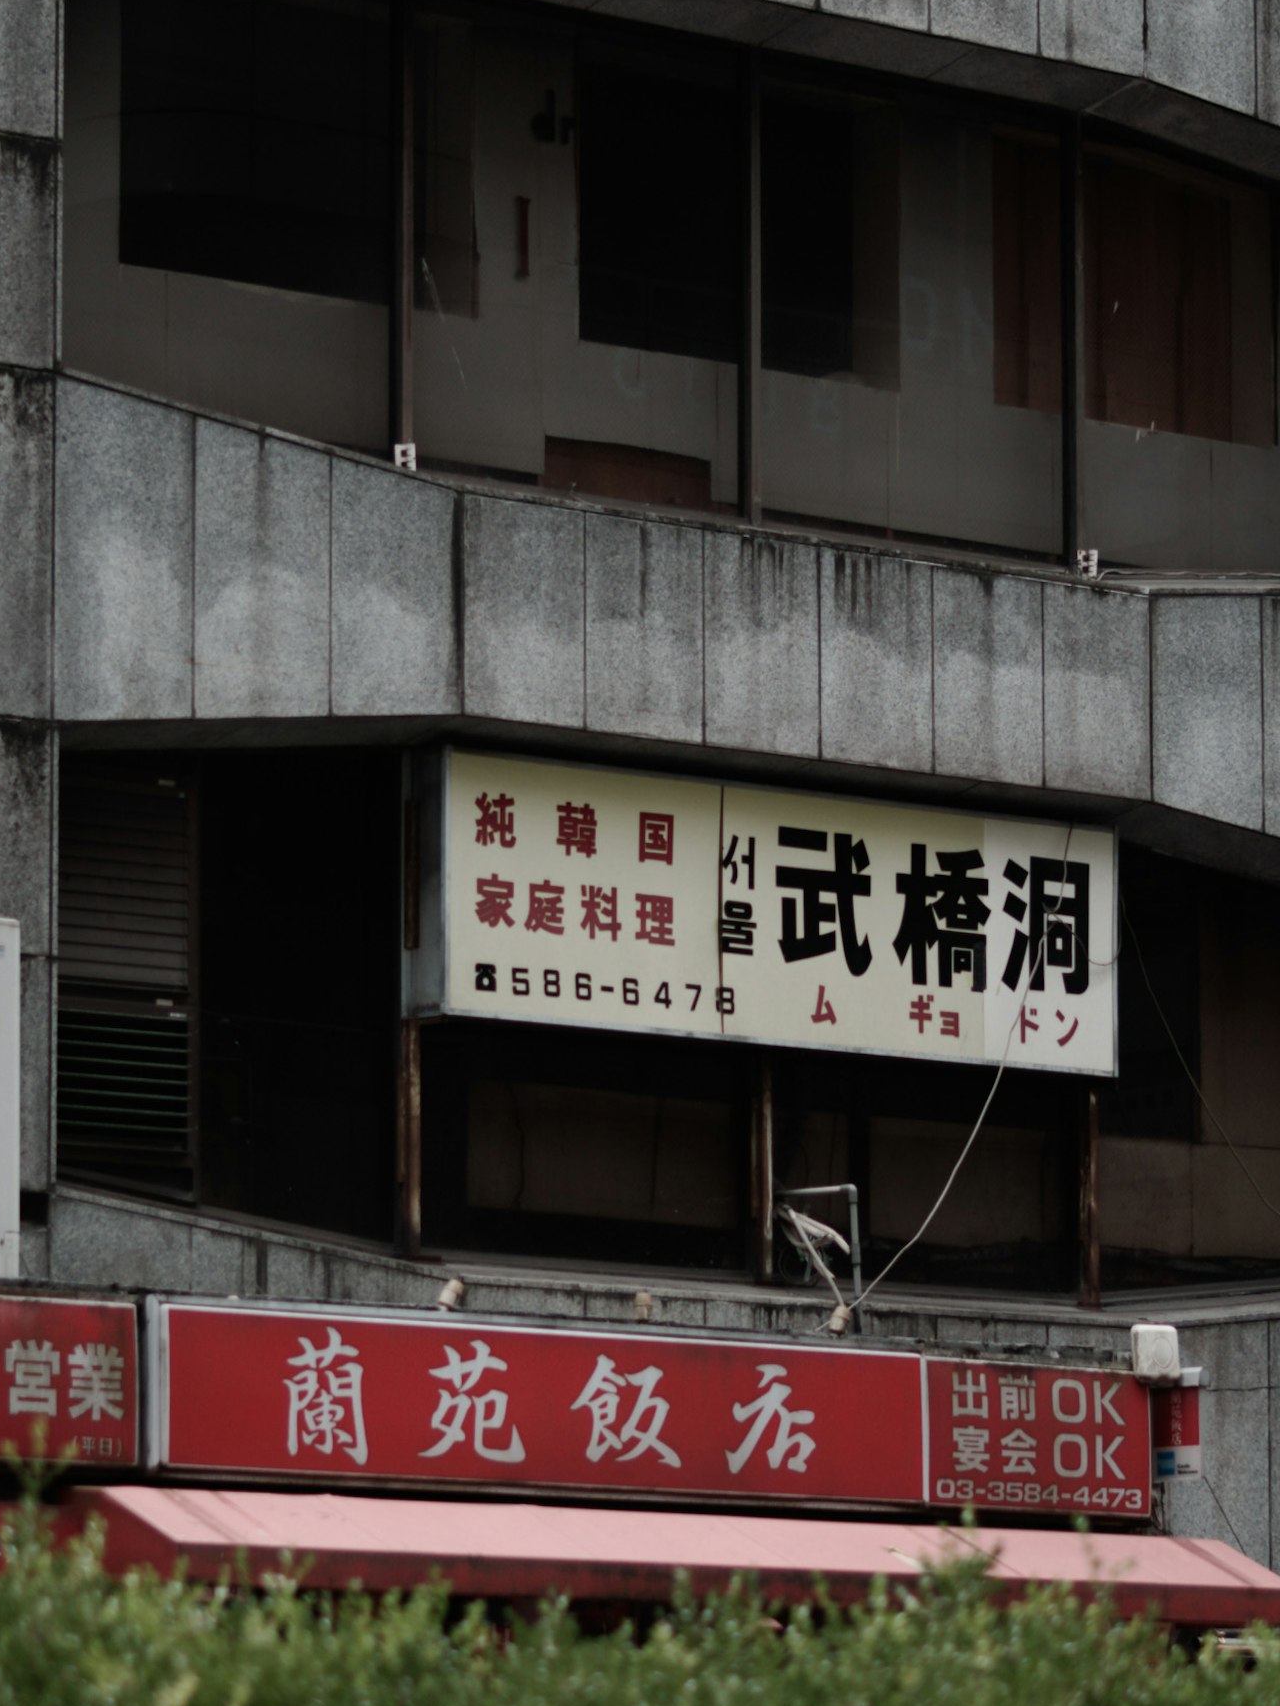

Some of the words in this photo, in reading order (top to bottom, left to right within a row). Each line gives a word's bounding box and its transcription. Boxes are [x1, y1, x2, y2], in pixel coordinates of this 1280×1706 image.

[474, 872, 676, 947] 家庭料理
[777, 825, 1091, 996] 武橋洞
[284, 1327, 818, 1476] 蘭苑飯店
[952, 1369, 1036, 1422] 出前
[1051, 1378, 1127, 1426] OK
[952, 1425, 1037, 1475] 宴会
[1053, 1433, 1127, 1480] OK
[936, 1478, 1143, 1510] 03-3584-4473
